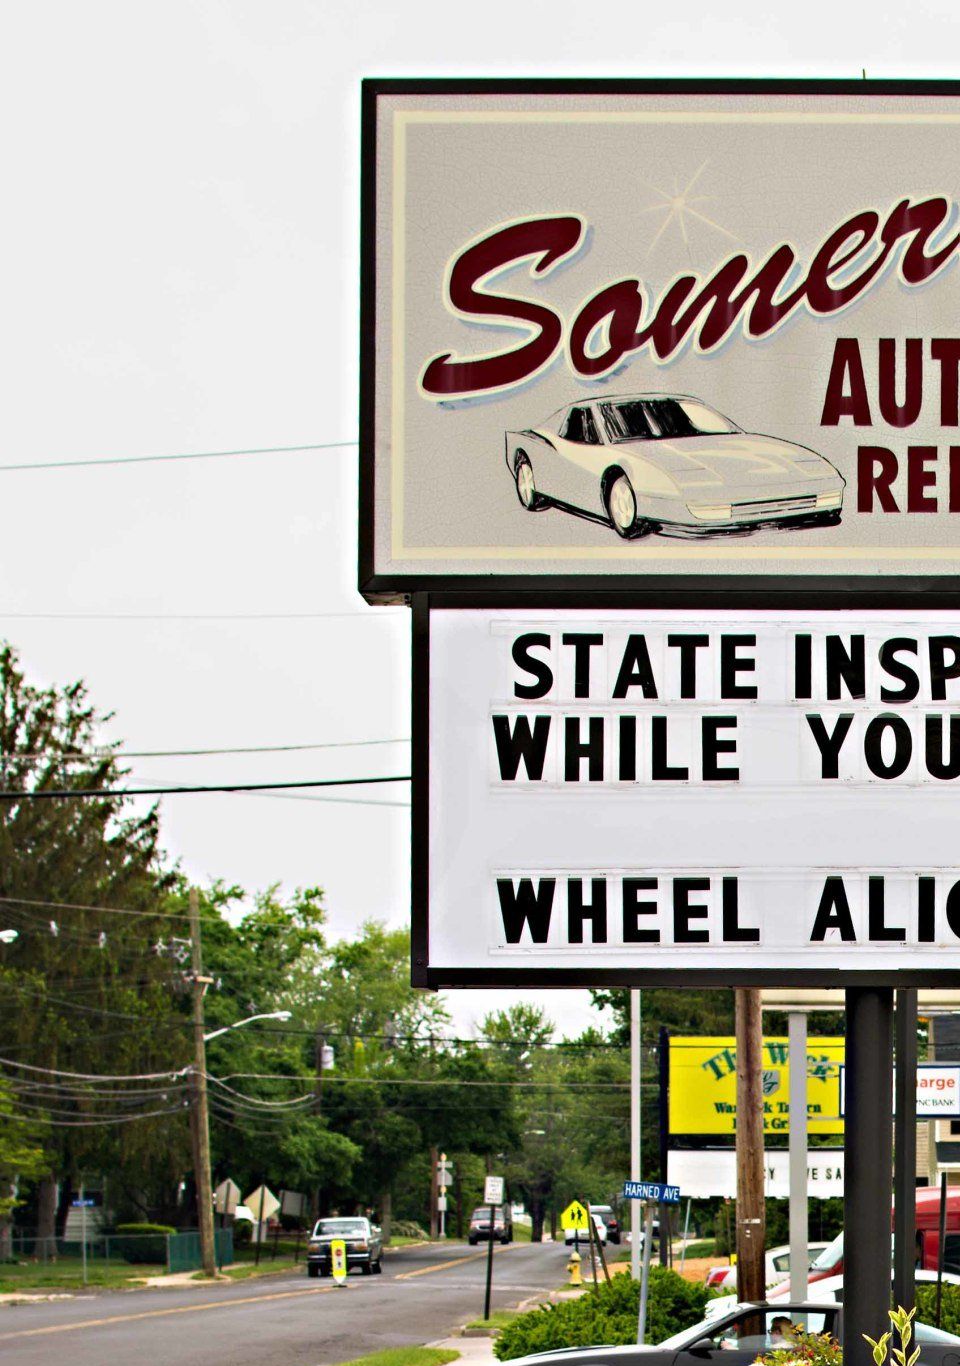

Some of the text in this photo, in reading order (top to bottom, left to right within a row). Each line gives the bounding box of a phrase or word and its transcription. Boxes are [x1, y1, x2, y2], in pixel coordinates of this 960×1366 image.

[511, 633, 758, 700] STATE
[491, 714, 740, 782] WHILE
[496, 876, 760, 944] WHEEL
[932, 1098, 955, 1107] BANK
[624, 1183, 680, 1201] HARNED AVE
